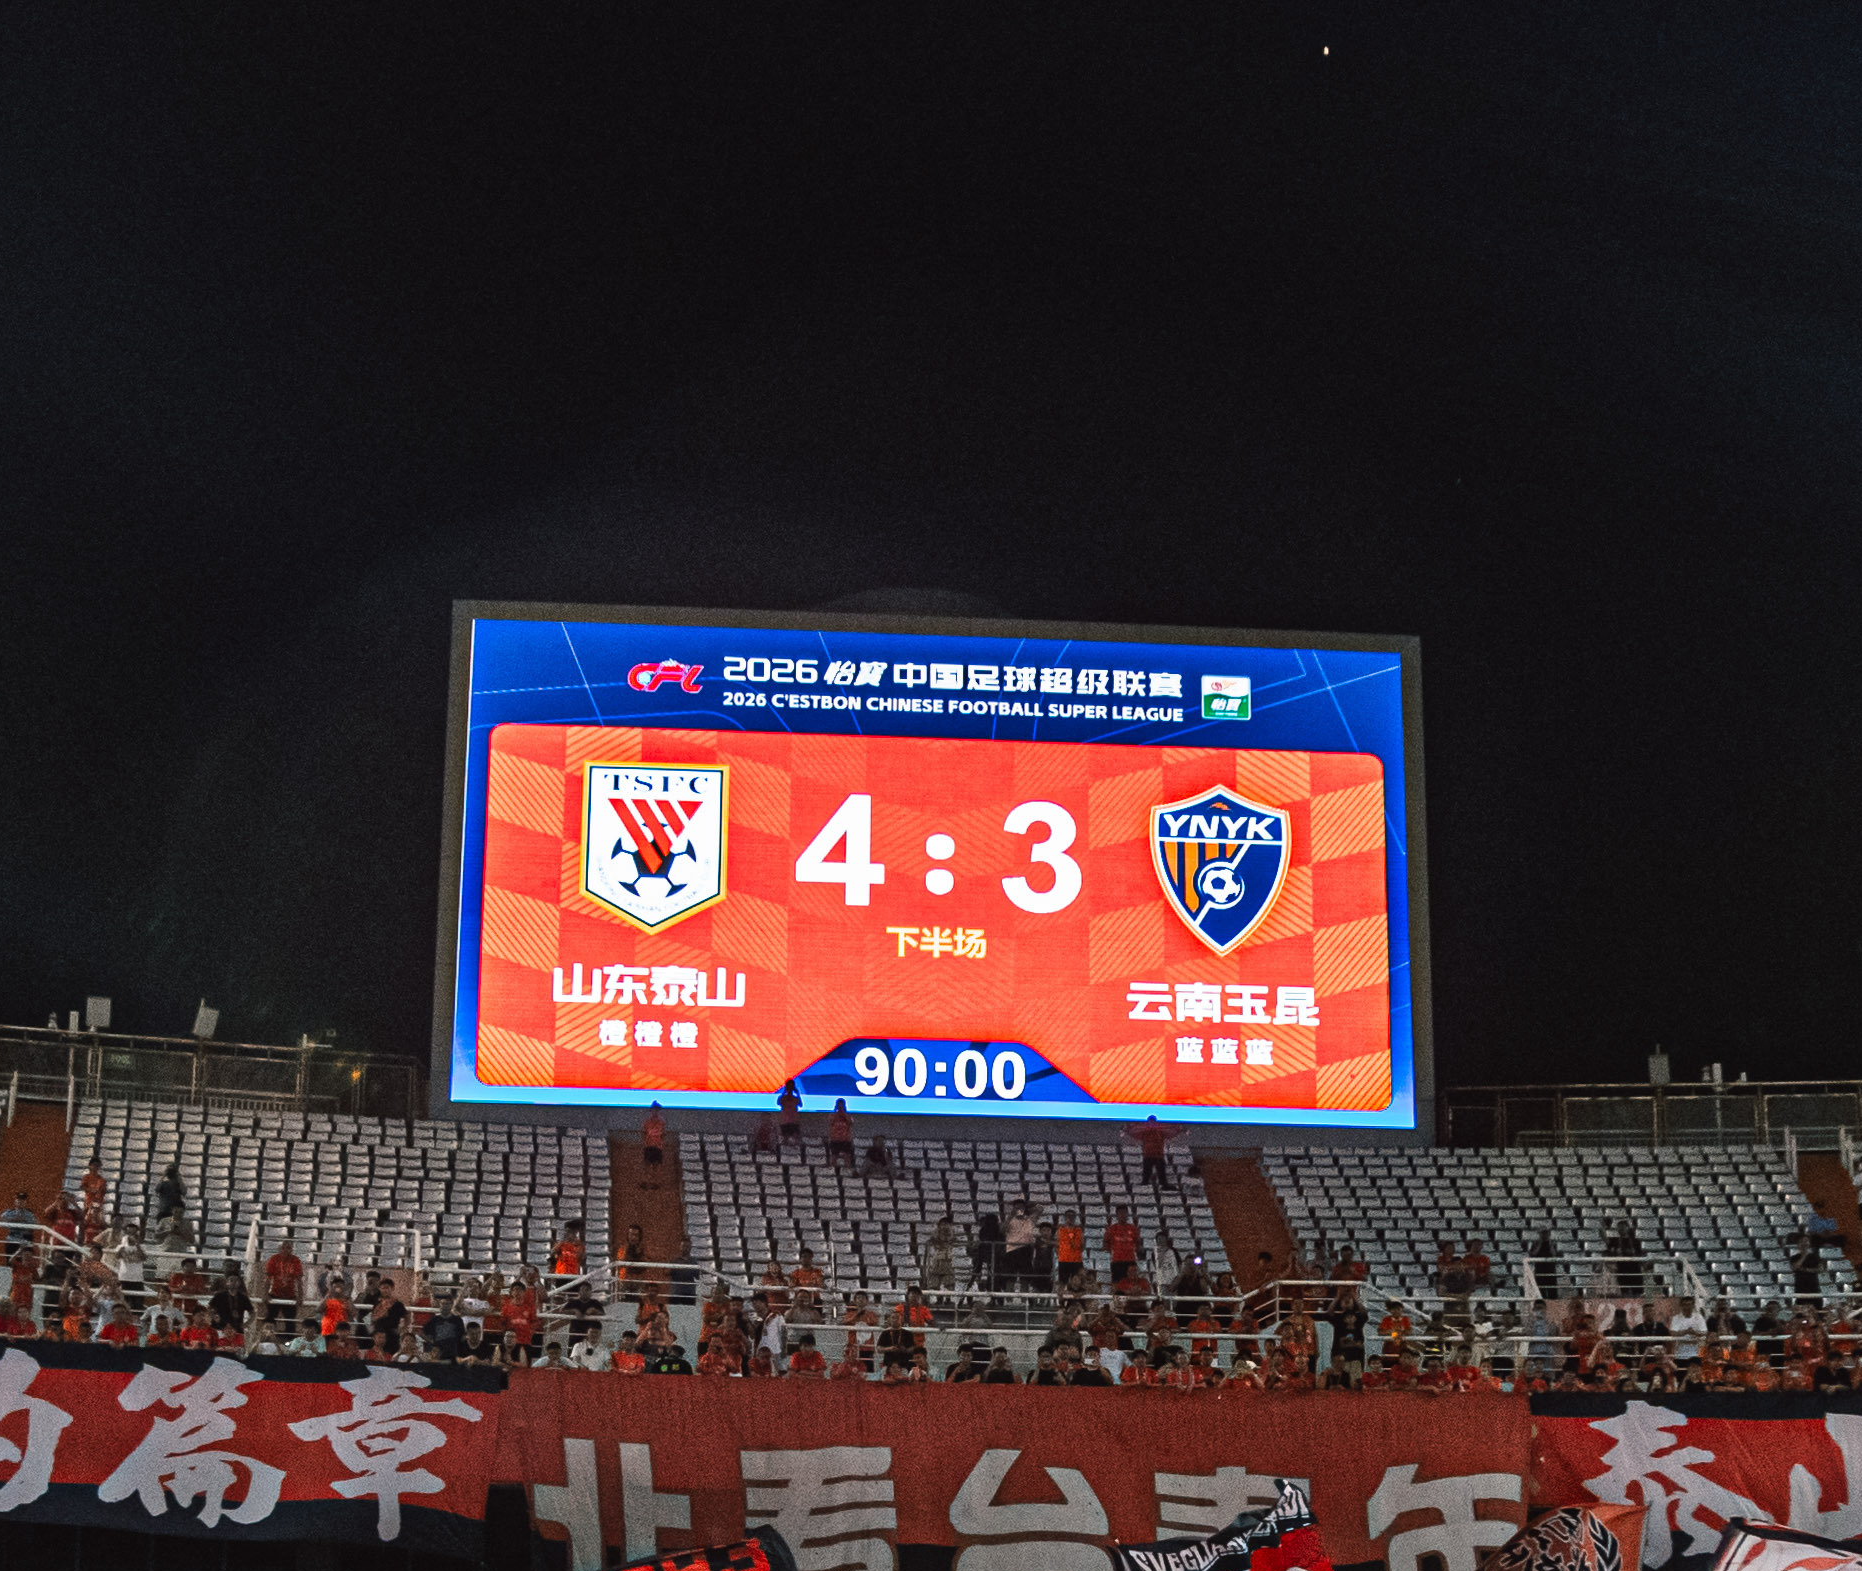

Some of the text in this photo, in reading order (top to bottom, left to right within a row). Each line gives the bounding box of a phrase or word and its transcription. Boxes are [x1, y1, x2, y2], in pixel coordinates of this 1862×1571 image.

[723, 656, 818, 682] 2026
[893, 663, 1183, 698] 中国足球超级联赛
[723, 692, 1183, 722] 2026 C'ESTBON CHINESE FOOTBALL SUPER LEAGUE
[604, 774, 708, 794] TSFC
[1163, 813, 1271, 841] YNYK
[794, 793, 885, 907] 4
[1000, 800, 1083, 915] 3
[886, 927, 987, 961] 下半场
[552, 963, 746, 1007] 山东泰山
[1126, 982, 1320, 1026] 云南玉昆
[854, 1048, 1026, 1100] 90:00
